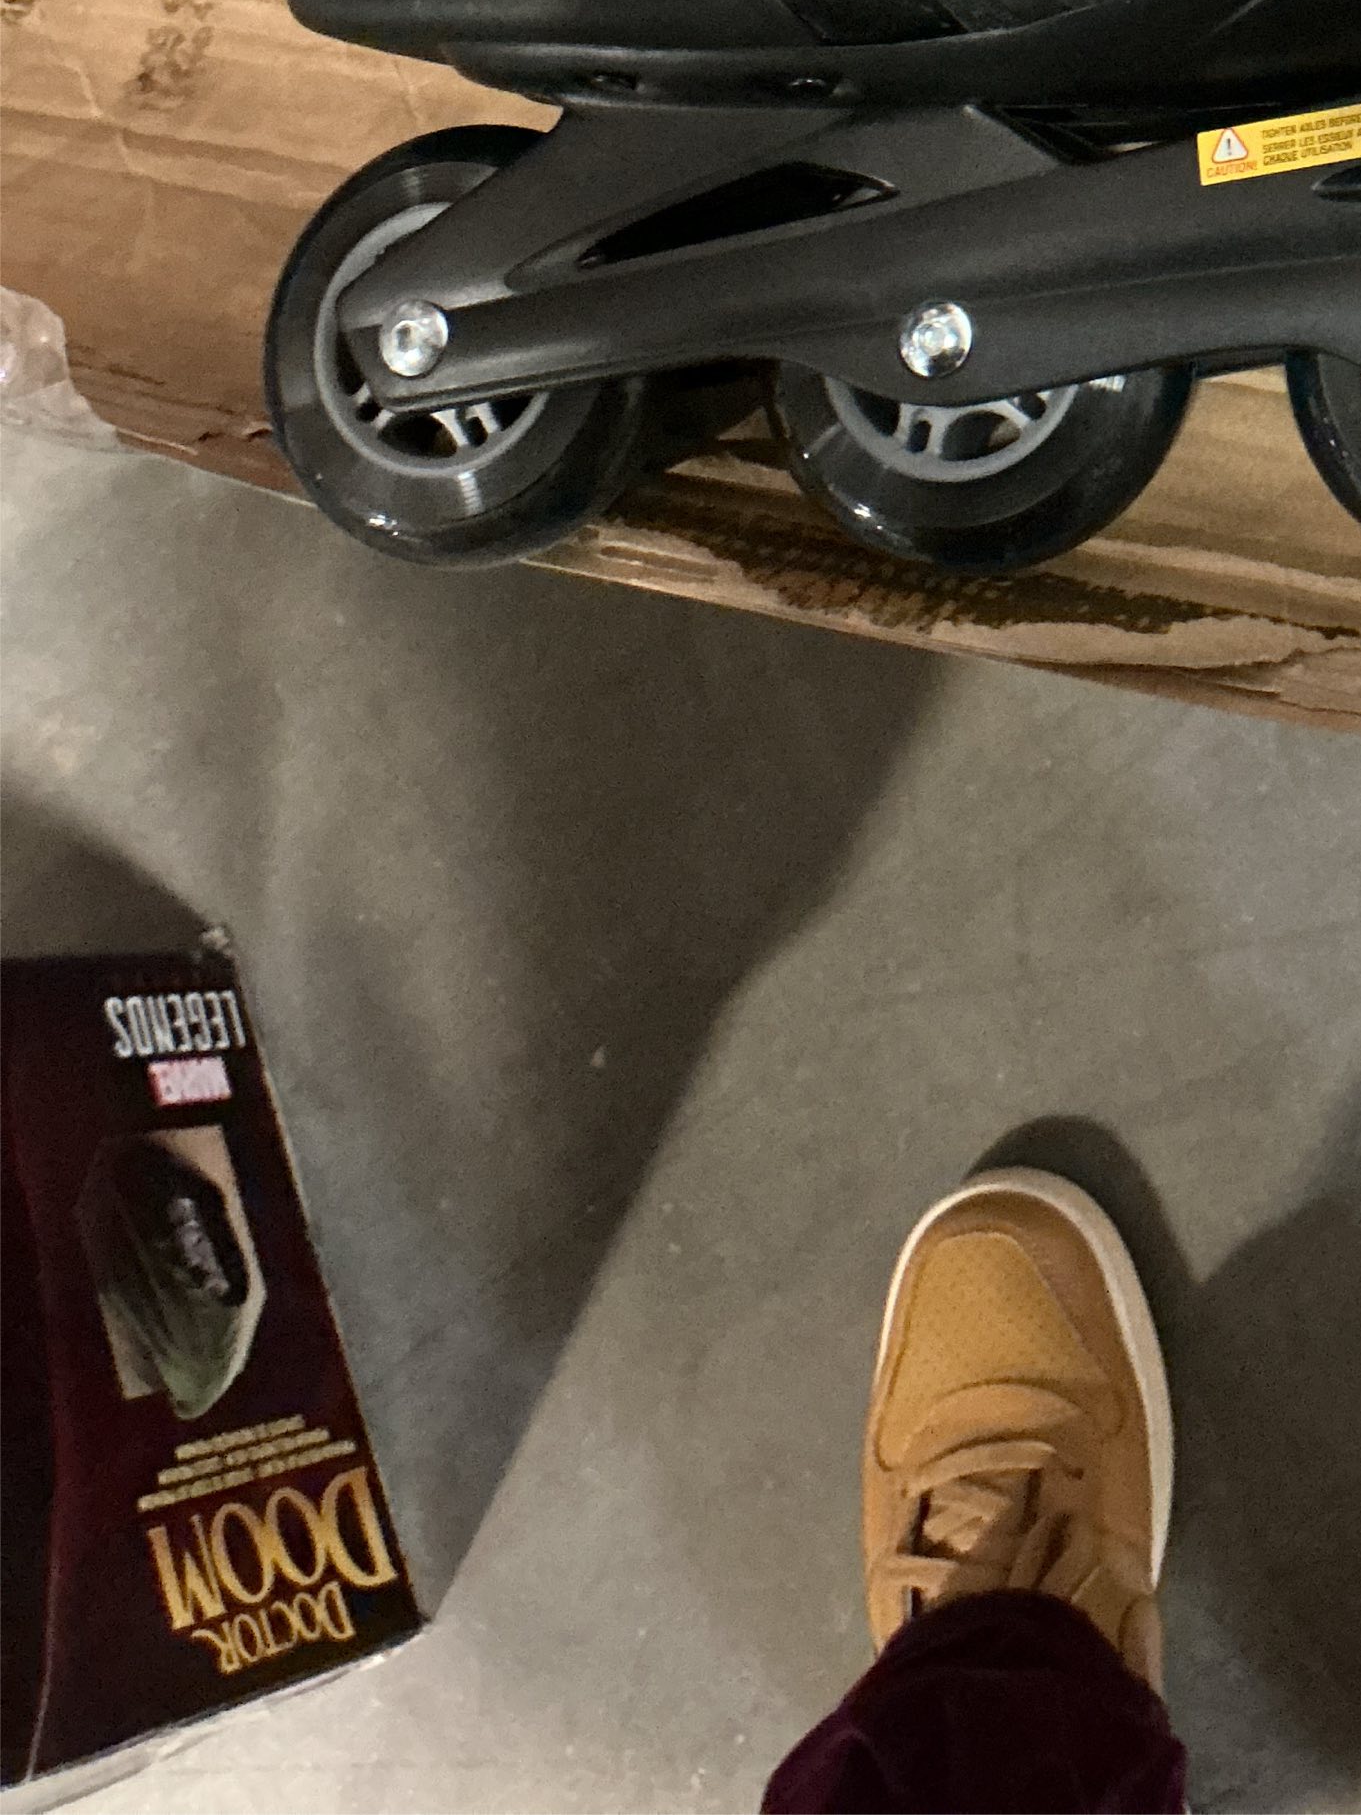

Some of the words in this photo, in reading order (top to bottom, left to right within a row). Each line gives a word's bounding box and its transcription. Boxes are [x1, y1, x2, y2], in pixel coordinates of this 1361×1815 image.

[1262, 123, 1297, 139] TIGHTEN
[1263, 150, 1298, 166] CHAQUE
[1300, 141, 1353, 159] UTILISATION
[1299, 134, 1317, 148] LES
[104, 989, 247, 1059] LEGENDS
[145, 1465, 398, 1631] DOOM
[189, 1581, 357, 1676] DOCTOR
